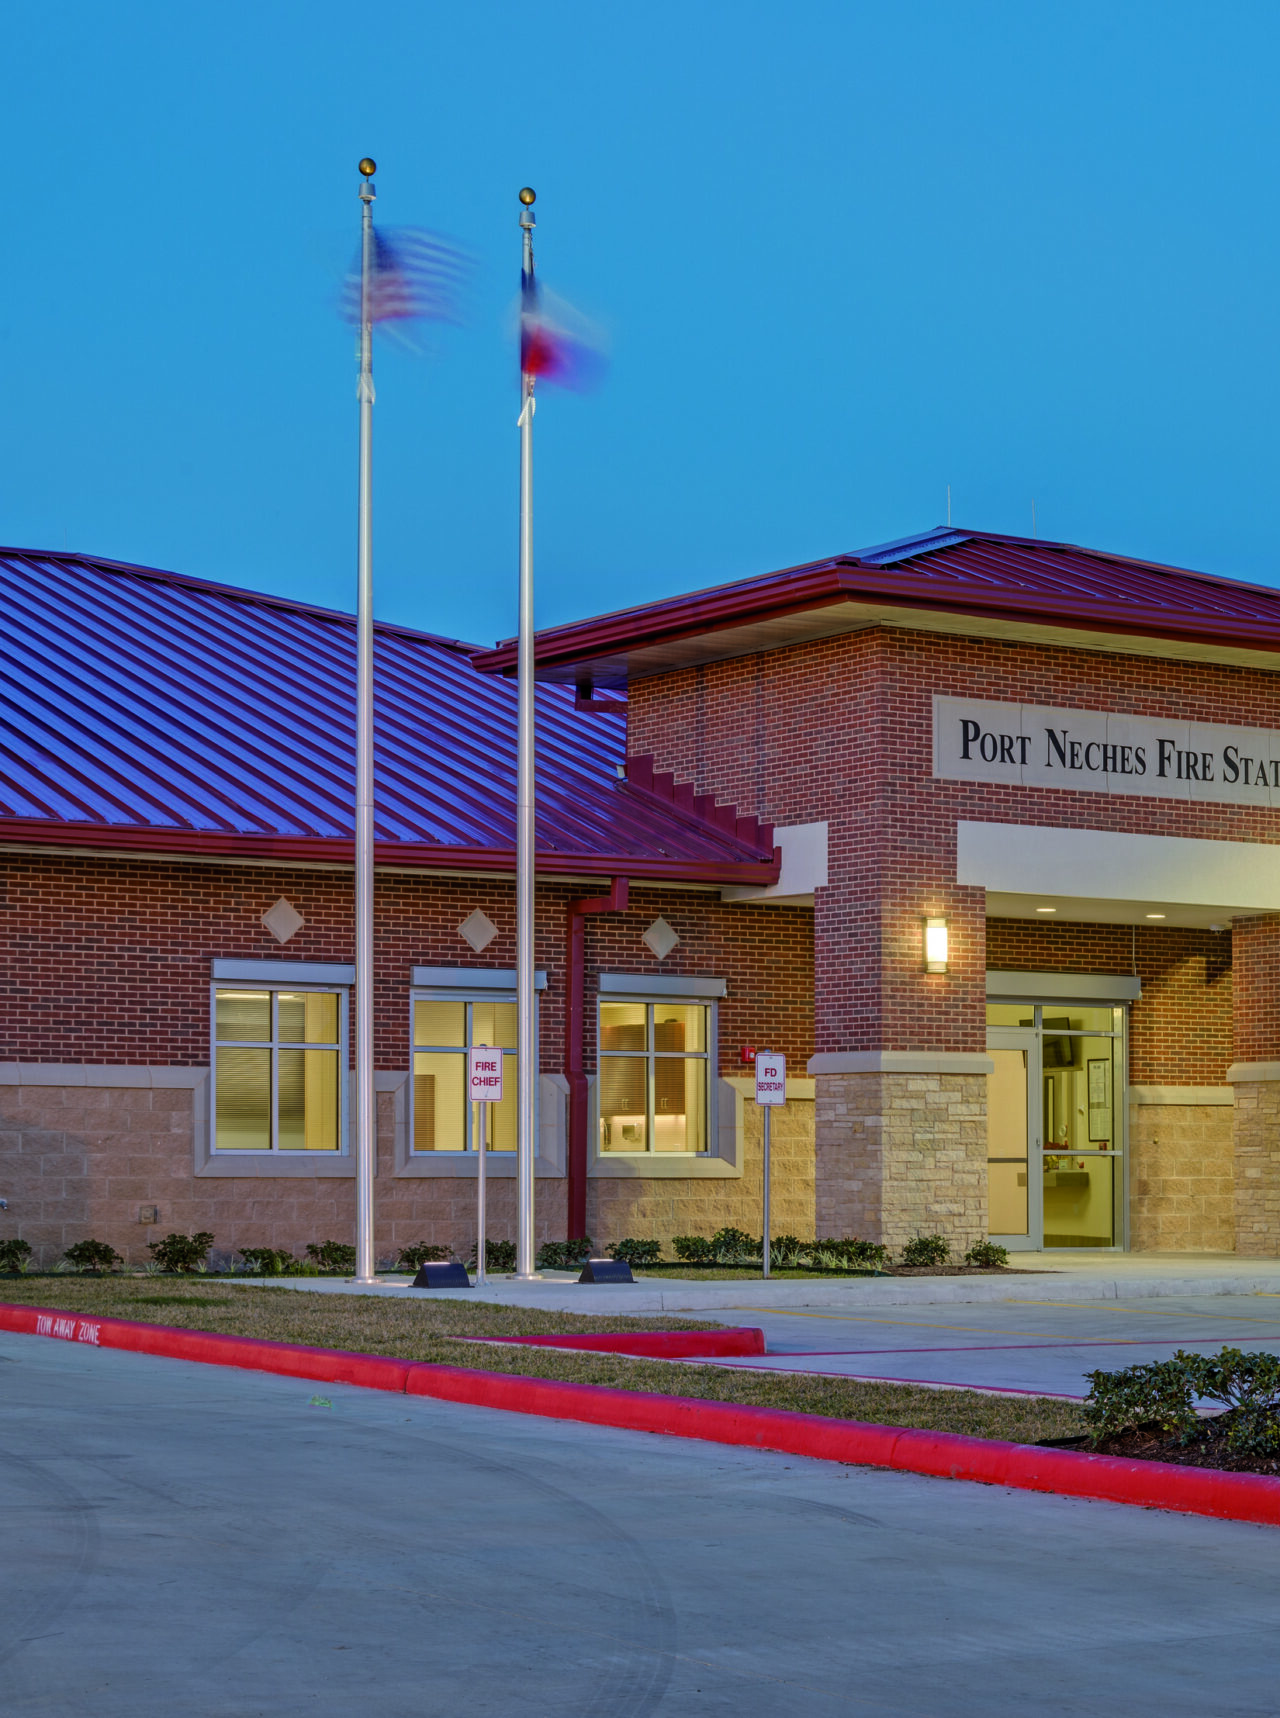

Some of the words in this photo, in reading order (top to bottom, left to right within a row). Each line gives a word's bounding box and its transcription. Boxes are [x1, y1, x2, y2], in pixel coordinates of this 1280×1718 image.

[959, 718, 1031, 765] PORT
[1044, 727, 1147, 776] NECHES
[1155, 738, 1214, 782] FIRE
[475, 1061, 497, 1072] FIRE
[764, 1067, 777, 1078] FD
[471, 1076, 501, 1087] CHIEF
[758, 1081, 783, 1092] SECRETARY
[36, 1315, 53, 1335] TOW
[53, 1318, 76, 1340] AWAY
[78, 1321, 101, 1344] ZONE
